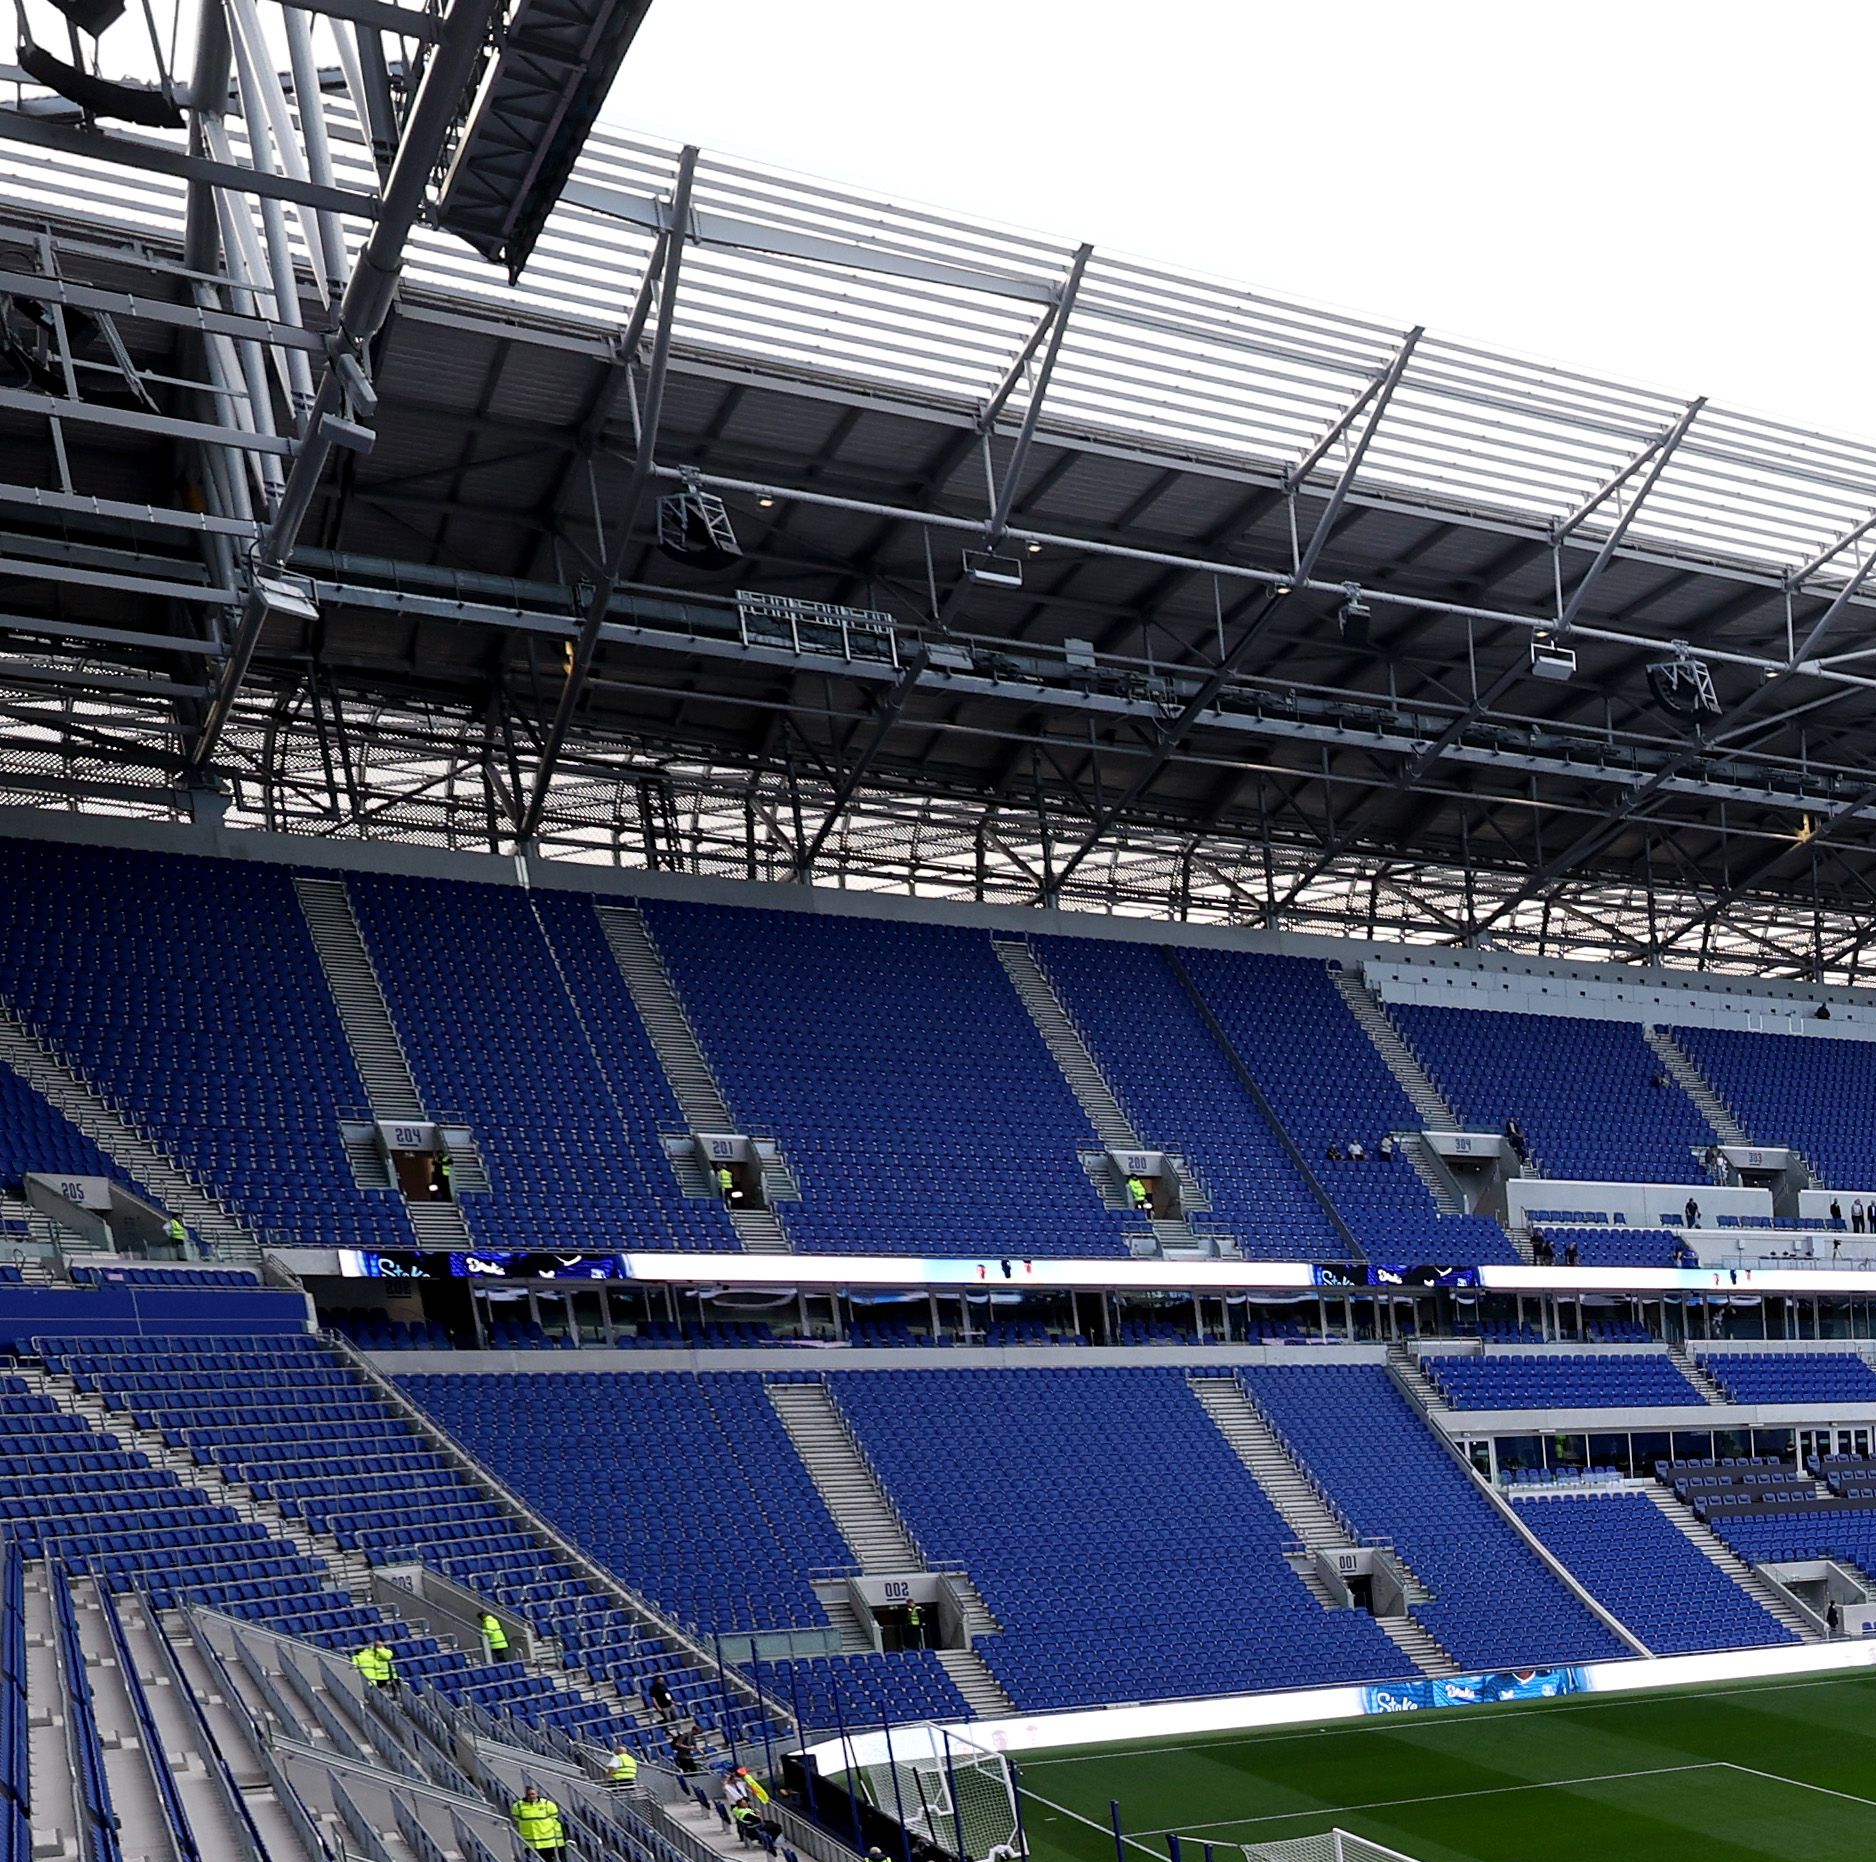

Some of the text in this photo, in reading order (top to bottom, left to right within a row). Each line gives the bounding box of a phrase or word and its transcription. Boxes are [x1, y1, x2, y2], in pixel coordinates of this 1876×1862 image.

[395, 1128, 422, 1143] 204
[712, 1141, 733, 1155] 201
[1456, 1138, 1472, 1150] 304
[1128, 1157, 1147, 1169] 200
[1748, 1152, 1762, 1164] 303
[62, 1182, 84, 1200] 205
[1339, 1555, 1357, 1569] 001
[885, 1582, 909, 1597] 002
